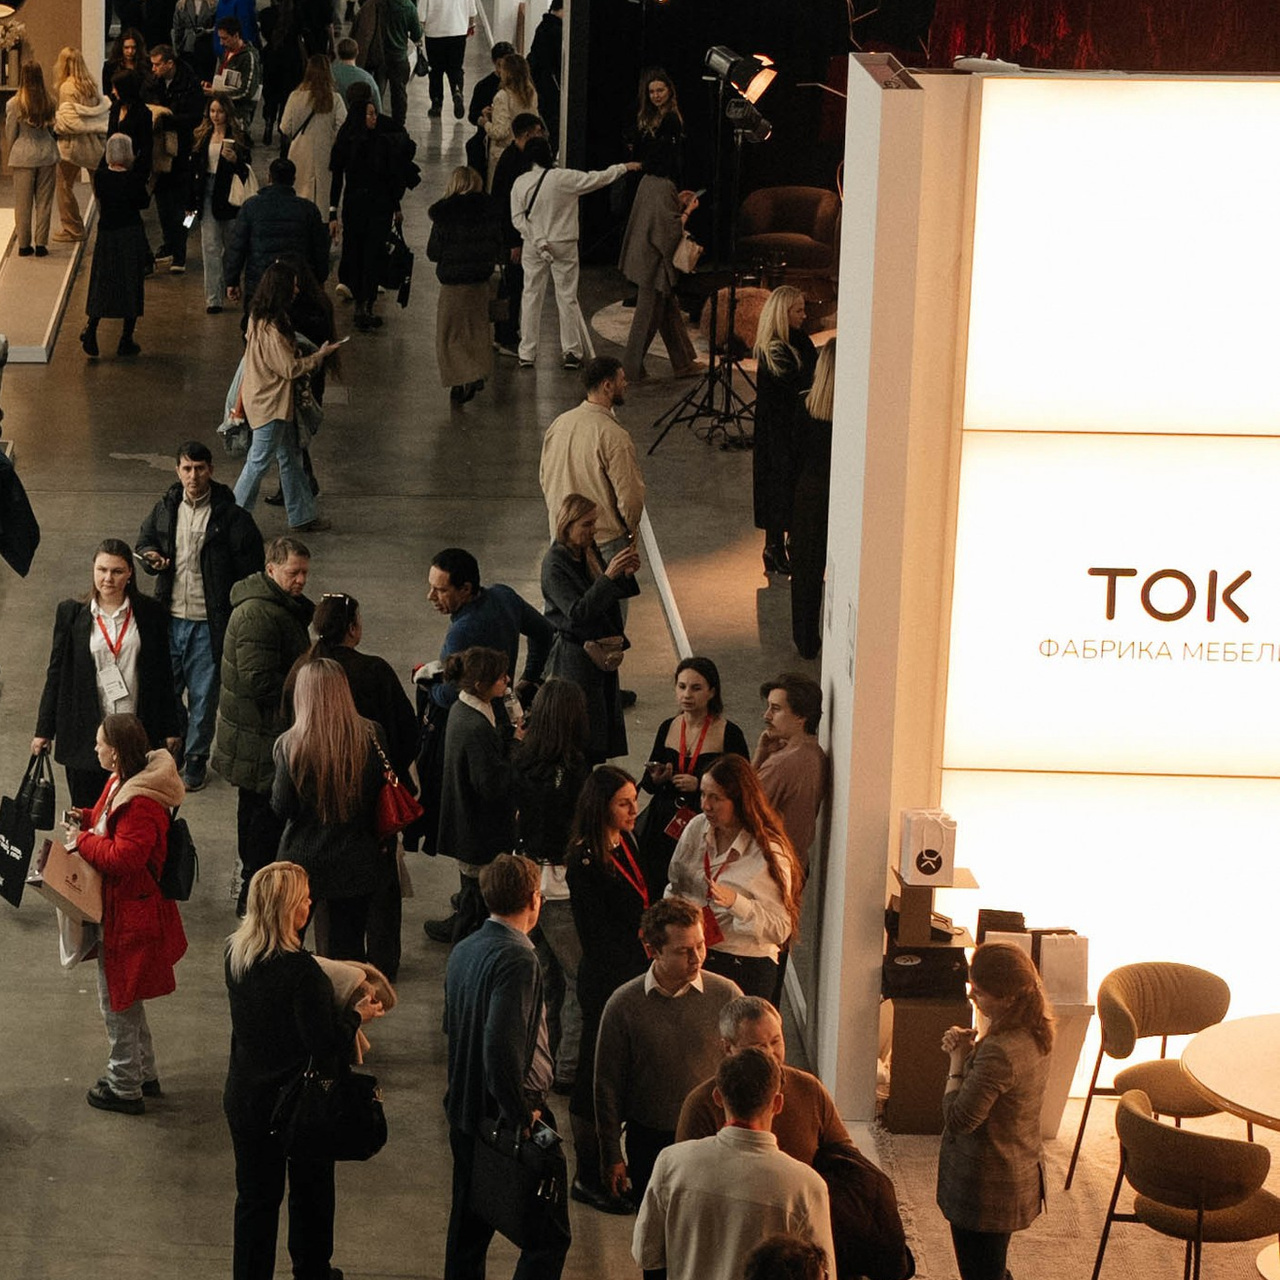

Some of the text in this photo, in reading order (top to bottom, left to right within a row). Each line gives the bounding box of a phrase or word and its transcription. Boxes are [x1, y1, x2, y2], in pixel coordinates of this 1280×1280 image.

[1087, 567, 1252, 623] ТОК
[1038, 638, 1280, 663] ФАБРИКА МЕБЕЛ
